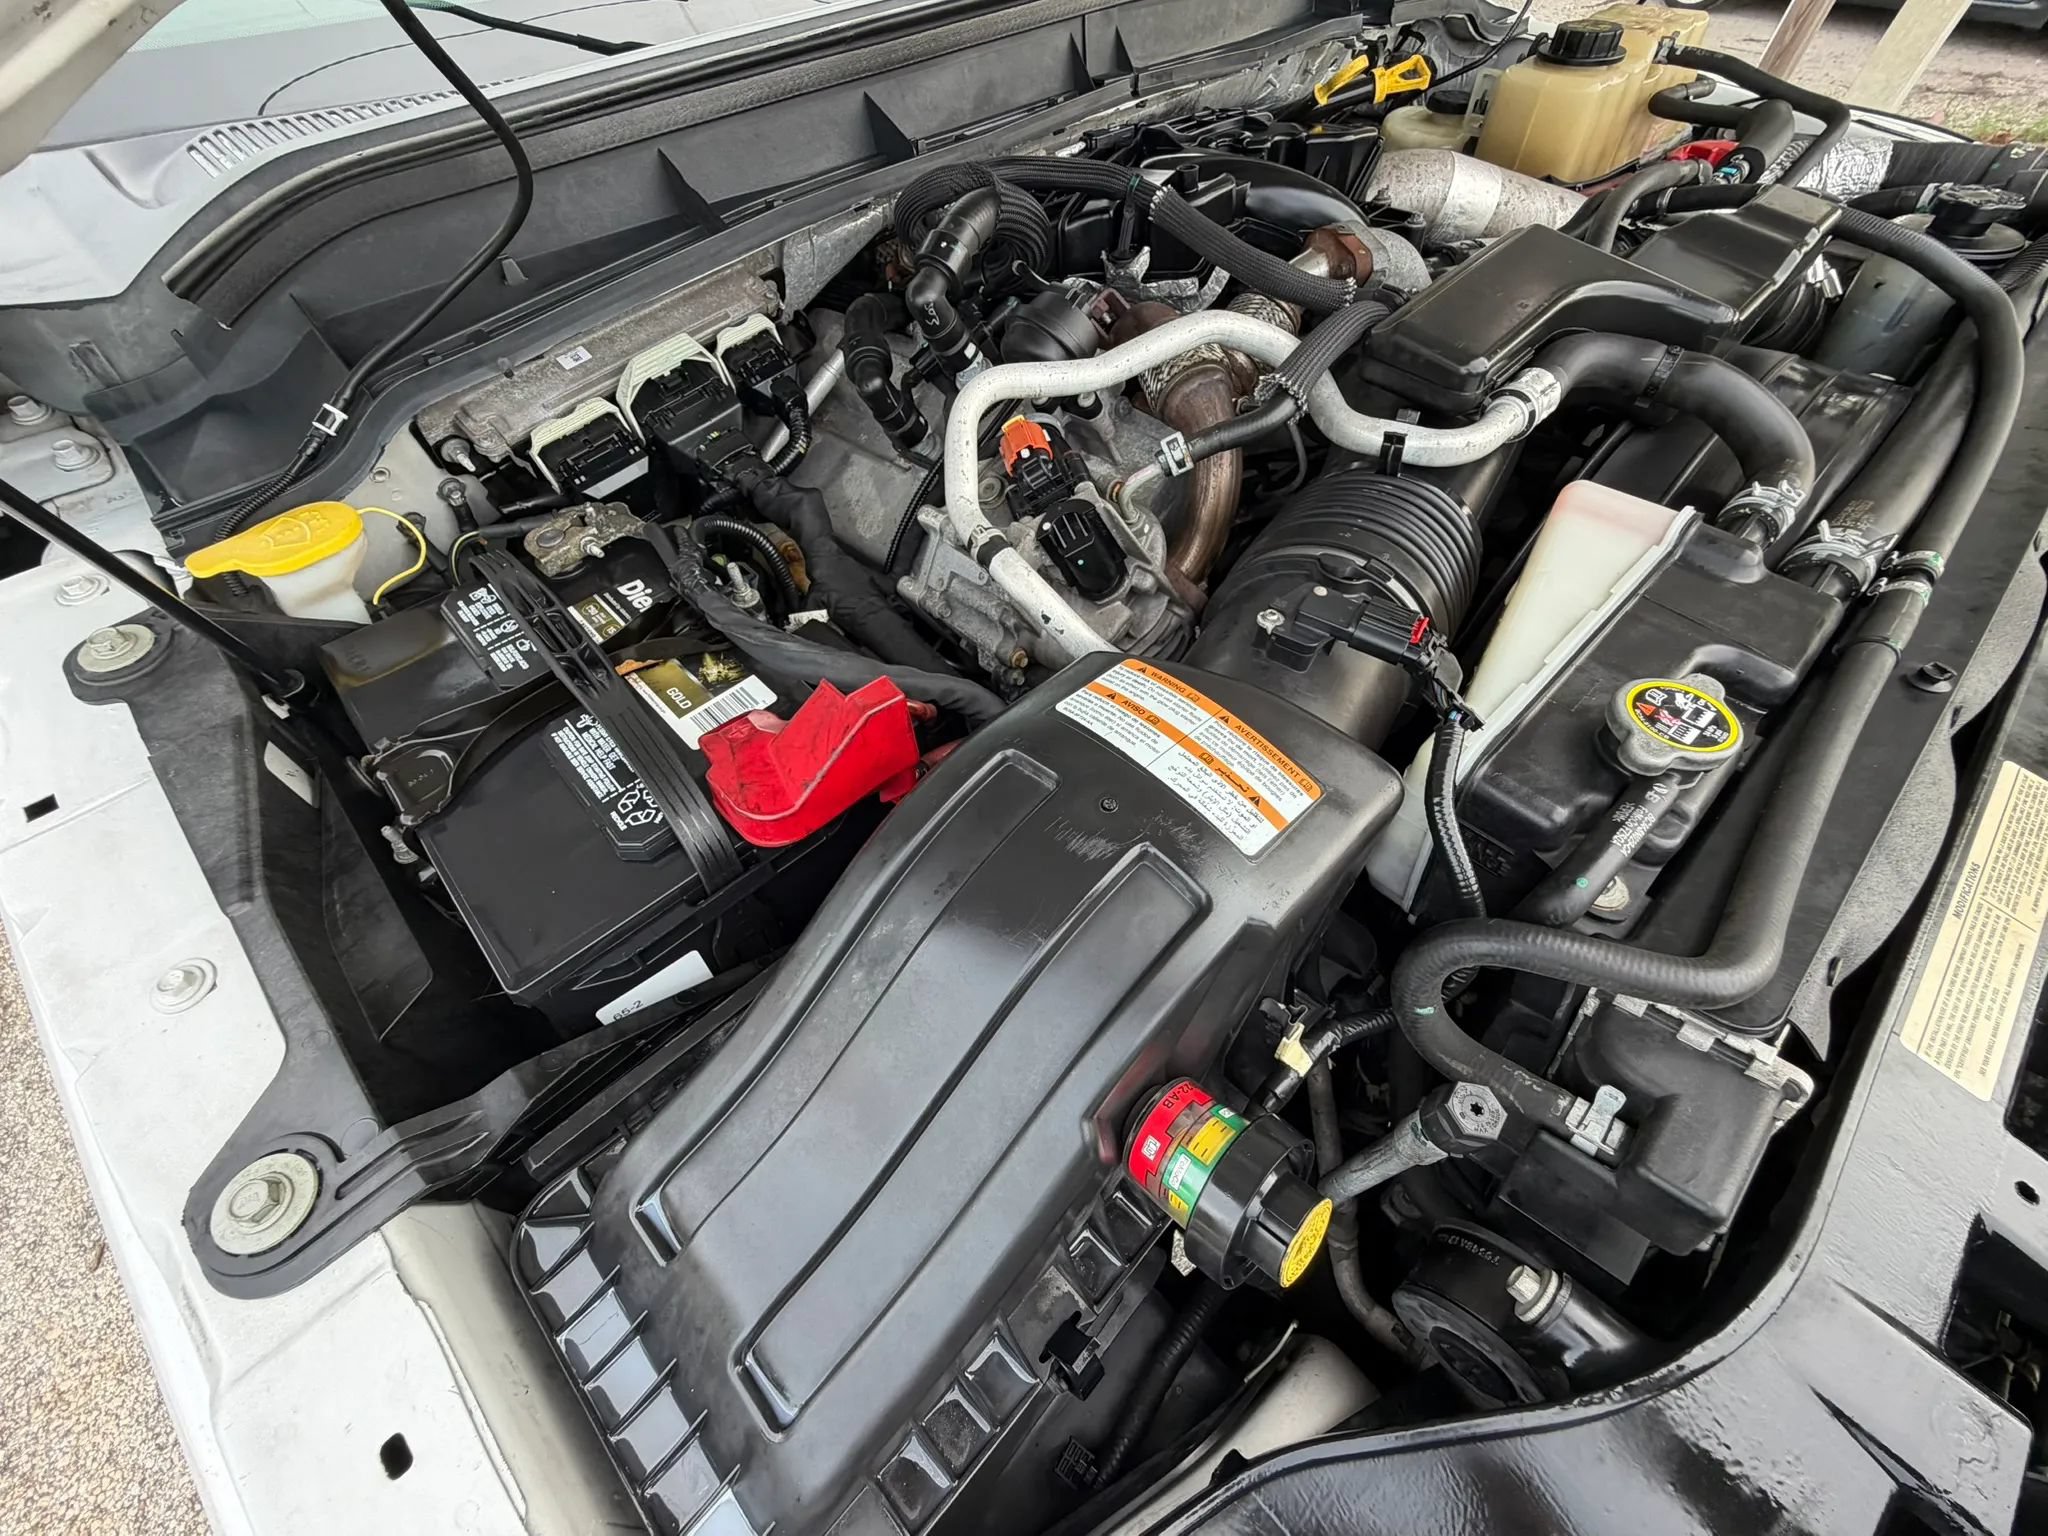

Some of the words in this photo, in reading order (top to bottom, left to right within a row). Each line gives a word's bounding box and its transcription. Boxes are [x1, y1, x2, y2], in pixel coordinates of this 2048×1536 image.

[1150, 671, 1186, 693] WARNING
[666, 686, 692, 709] GOLD
[1121, 699, 1146, 715] AVISO
[1235, 723, 1300, 778] AVERTISSEMENT
[1952, 862, 1980, 921] MODIFICATIONS
[612, 999, 643, 1020] 65-2
[1162, 1082, 1194, 1109] 22-AB
